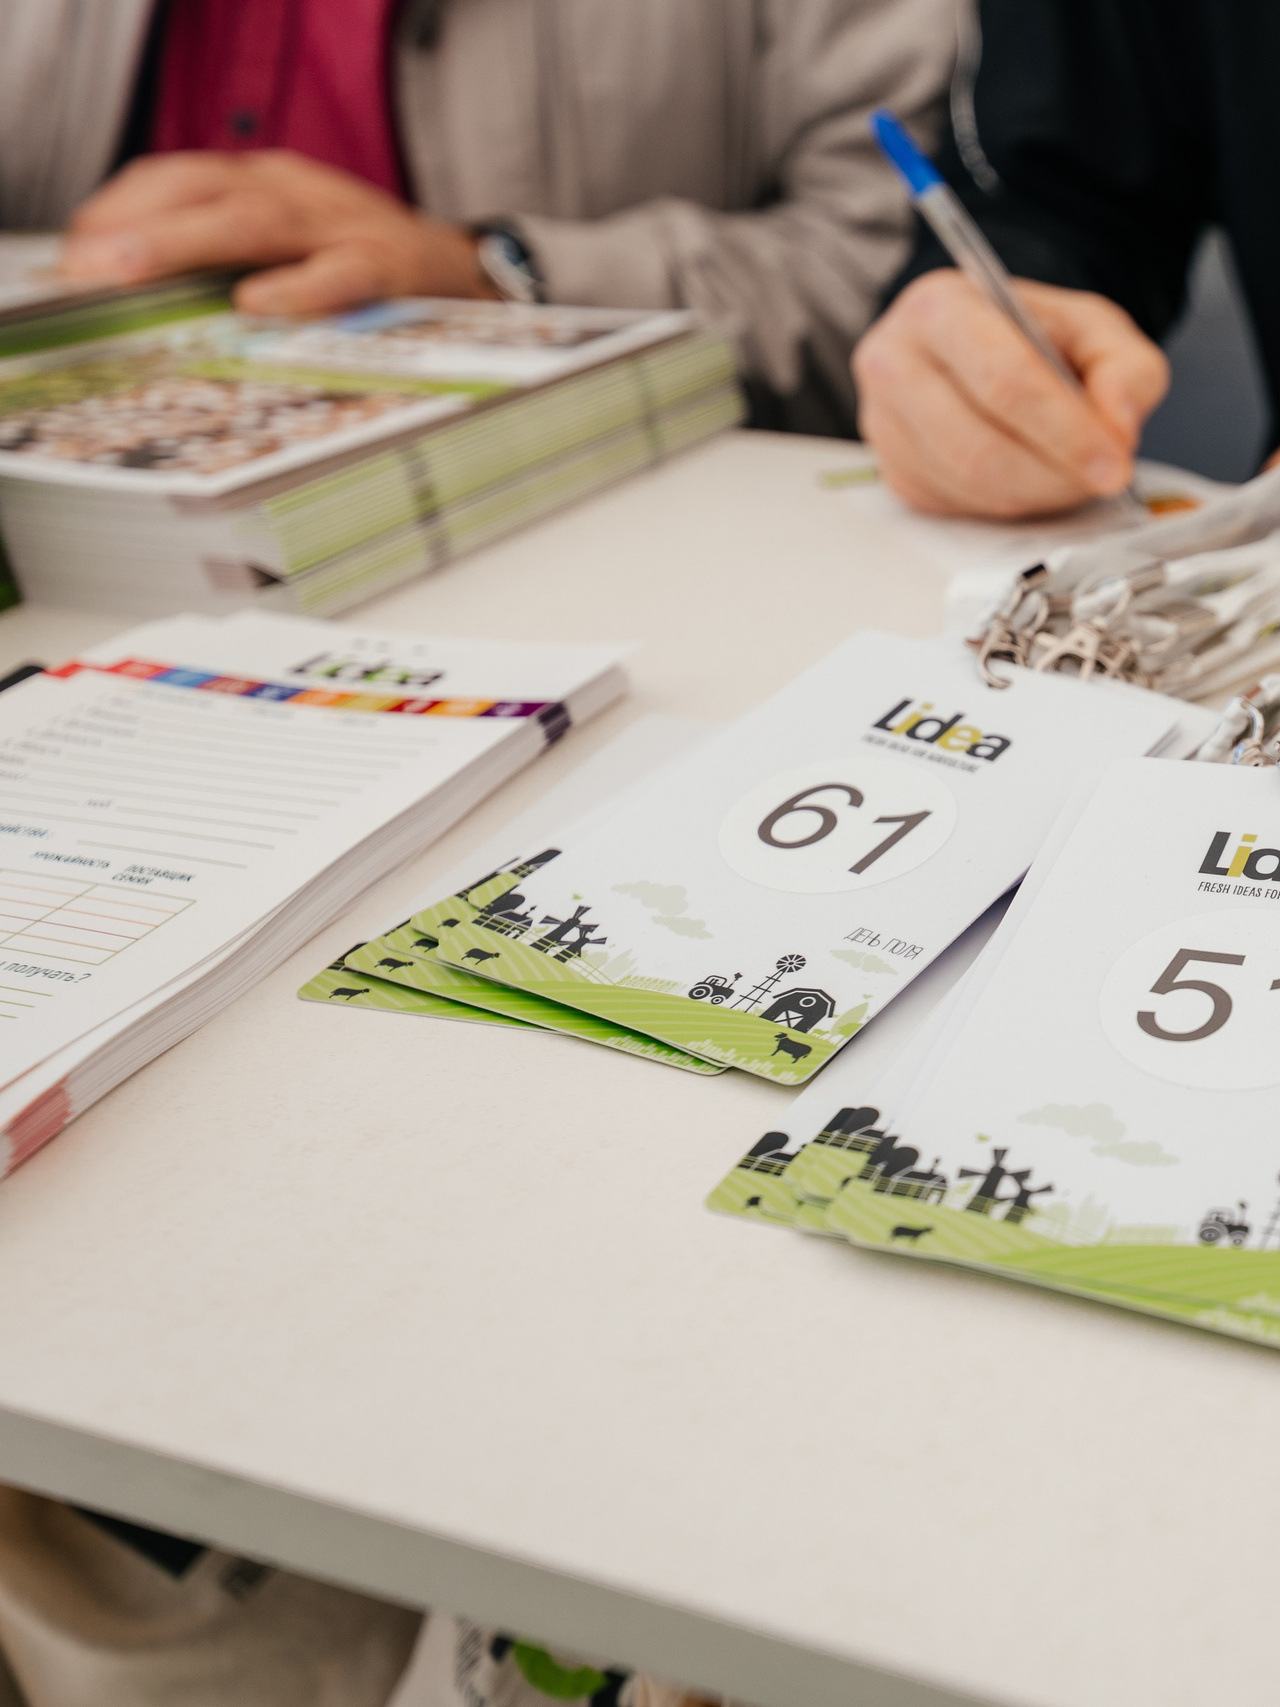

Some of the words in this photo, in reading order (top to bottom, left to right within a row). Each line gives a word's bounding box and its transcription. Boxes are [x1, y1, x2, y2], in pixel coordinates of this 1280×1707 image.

[872, 698, 1012, 762] Lidea
[757, 783, 934, 875] 61
[1197, 881, 1231, 894] FRESH
[1232, 885, 1263, 898] IDEAS
[843, 927, 881, 947] ДЕНЬ
[881, 938, 924, 960] ПОЛЯ
[3, 962, 92, 984] получать?
